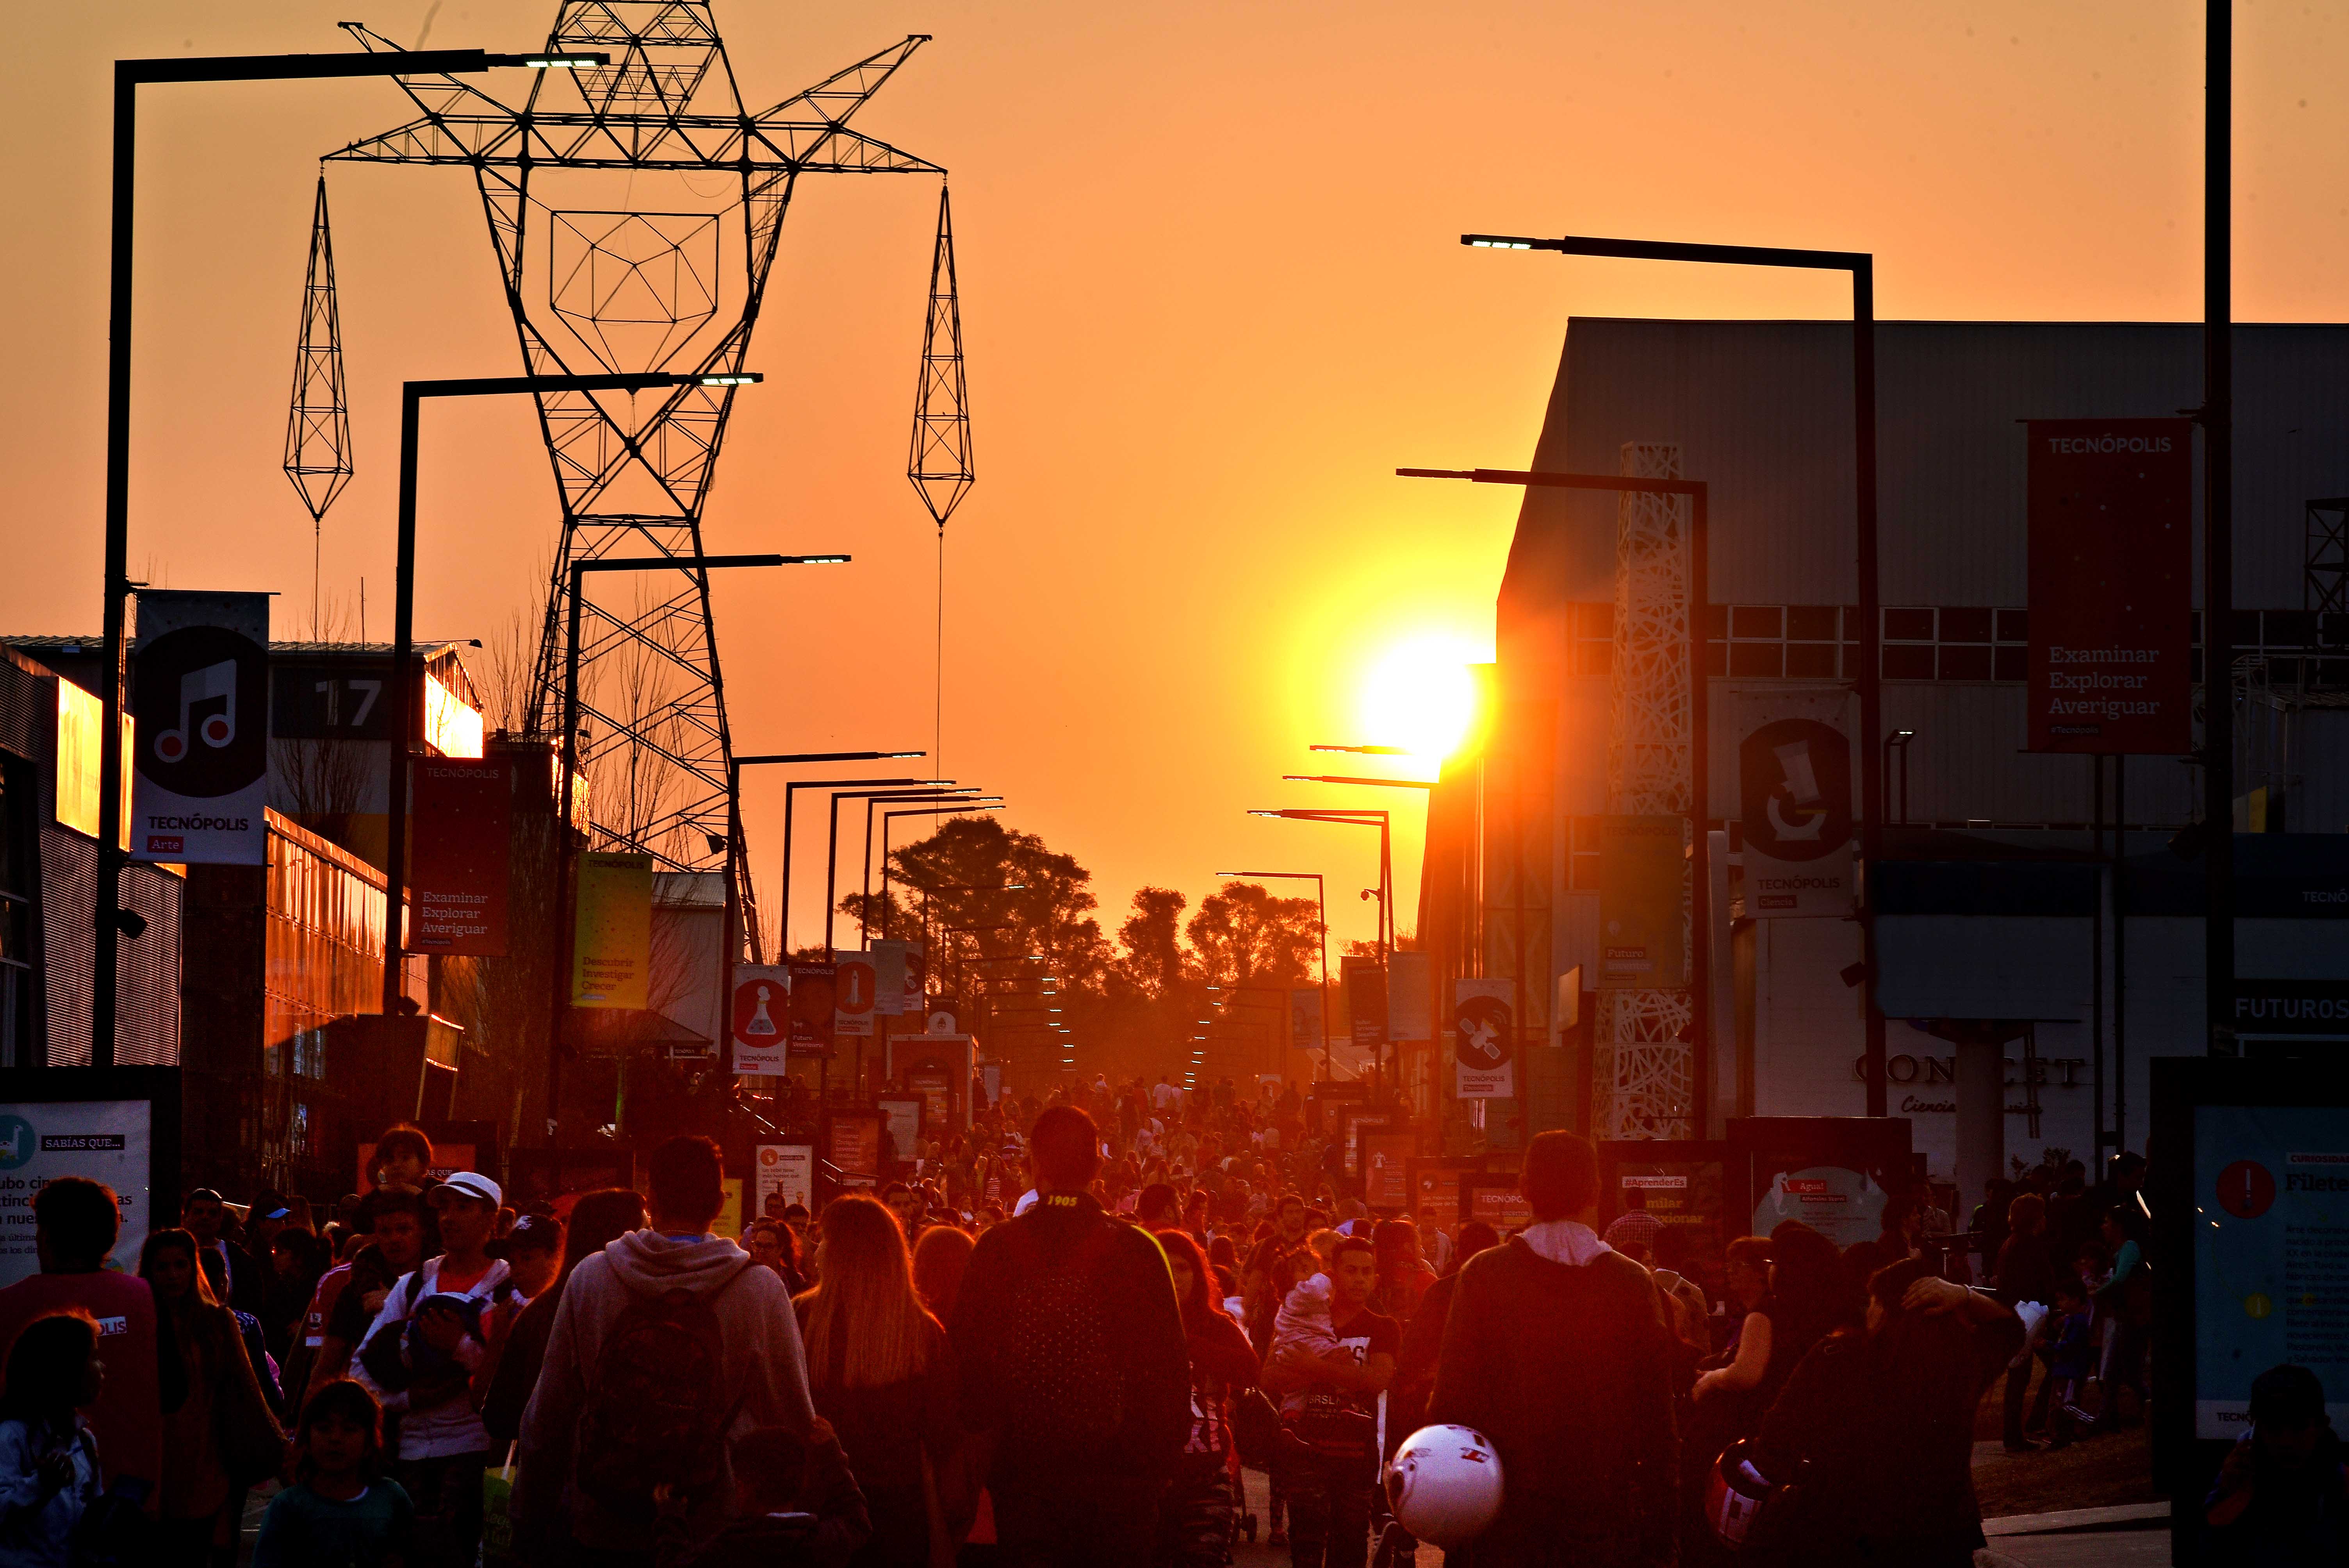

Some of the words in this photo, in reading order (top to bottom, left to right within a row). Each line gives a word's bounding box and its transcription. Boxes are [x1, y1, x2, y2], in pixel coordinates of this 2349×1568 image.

[2049, 433, 2172, 454] TECNÓPOLIS
[2049, 643, 2160, 663] Examinar
[2049, 671, 2148, 692] Explorar
[315, 679, 381, 726] 17
[2048, 696, 2160, 720] Averiguar
[2051, 725, 2099, 735] #Tecnópolis
[426, 766, 499, 779] TECNÓPOLIS
[148, 813, 248, 831] TECNÓPOLIS
[1605, 825, 1678, 836] TECNÓPOLIS
[151, 840, 179, 850] Arte
[588, 859, 644, 869] TECNÓPOLIS
[1757, 875, 1840, 889] TECNÓPOLIS
[422, 892, 488, 903] Examinar
[2302, 888, 2347, 902] TECNÓ
[1761, 898, 1794, 906] Ciencia
[422, 907, 480, 919] Explorar
[422, 922, 487, 937] Averiguar
[1608, 949, 1644, 957] Futuro
[583, 957, 634, 967] Descubrir
[583, 969, 634, 981] Investigar
[794, 967, 834, 975] TECNÓPOLIS
[582, 981, 616, 990] Crecer
[2235, 998, 2349, 1018] FUTUROS
[45, 1137, 85, 1148] SABÍAS
[89, 1138, 120, 1148] QUE...
[1625, 1178, 1684, 1187] #AprenderEs
[1800, 1182, 1824, 1192] Agua!
[2286, 1171, 2349, 1192] Filete
[1048, 1195, 1078, 1206] 1905
